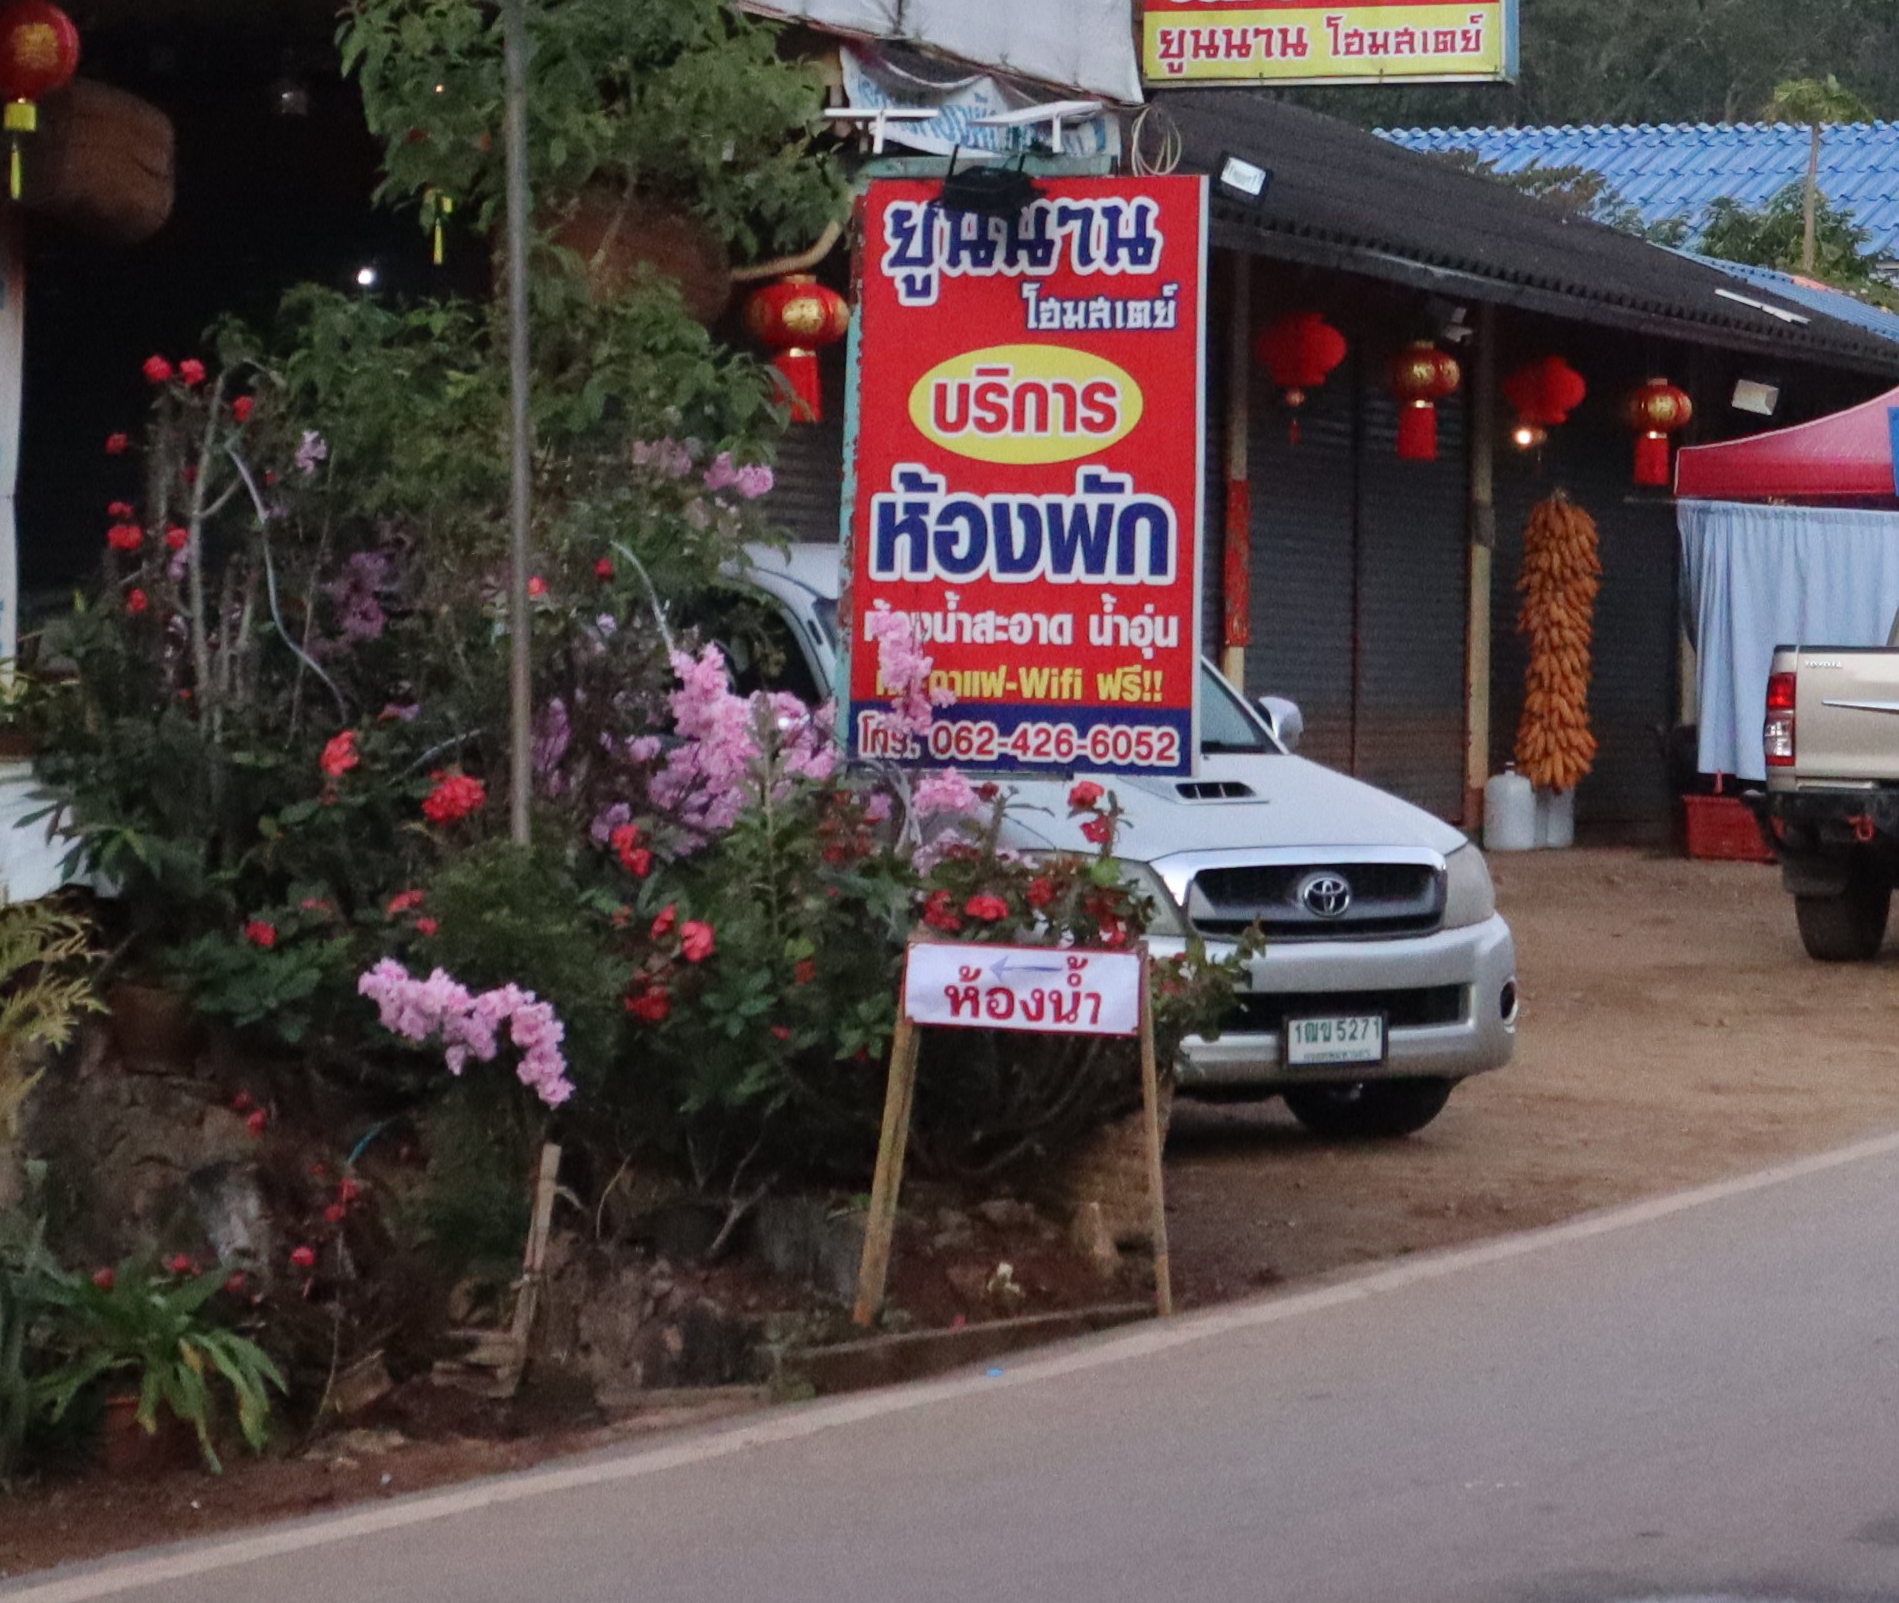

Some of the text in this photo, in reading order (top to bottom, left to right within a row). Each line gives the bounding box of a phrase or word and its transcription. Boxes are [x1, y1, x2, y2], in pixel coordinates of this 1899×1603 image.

[1158, 12, 1485, 75] ยูนนาน โฮมสเตย์
[884, 199, 1161, 303] ยูนนาน
[1022, 282, 1179, 330] โฮมสเตย์
[930, 365, 1119, 436] บริการ
[872, 465, 1174, 581] ห้องพัก
[1089, 593, 1178, 660] น้ำอุ่น
[1097, 664, 1163, 702] ฟรี!!
[930, 722, 1178, 765] 062-426-6052
[944, 955, 1102, 1025] ห้องน้ำ
[1336, 1016, 1380, 1042] 5271
